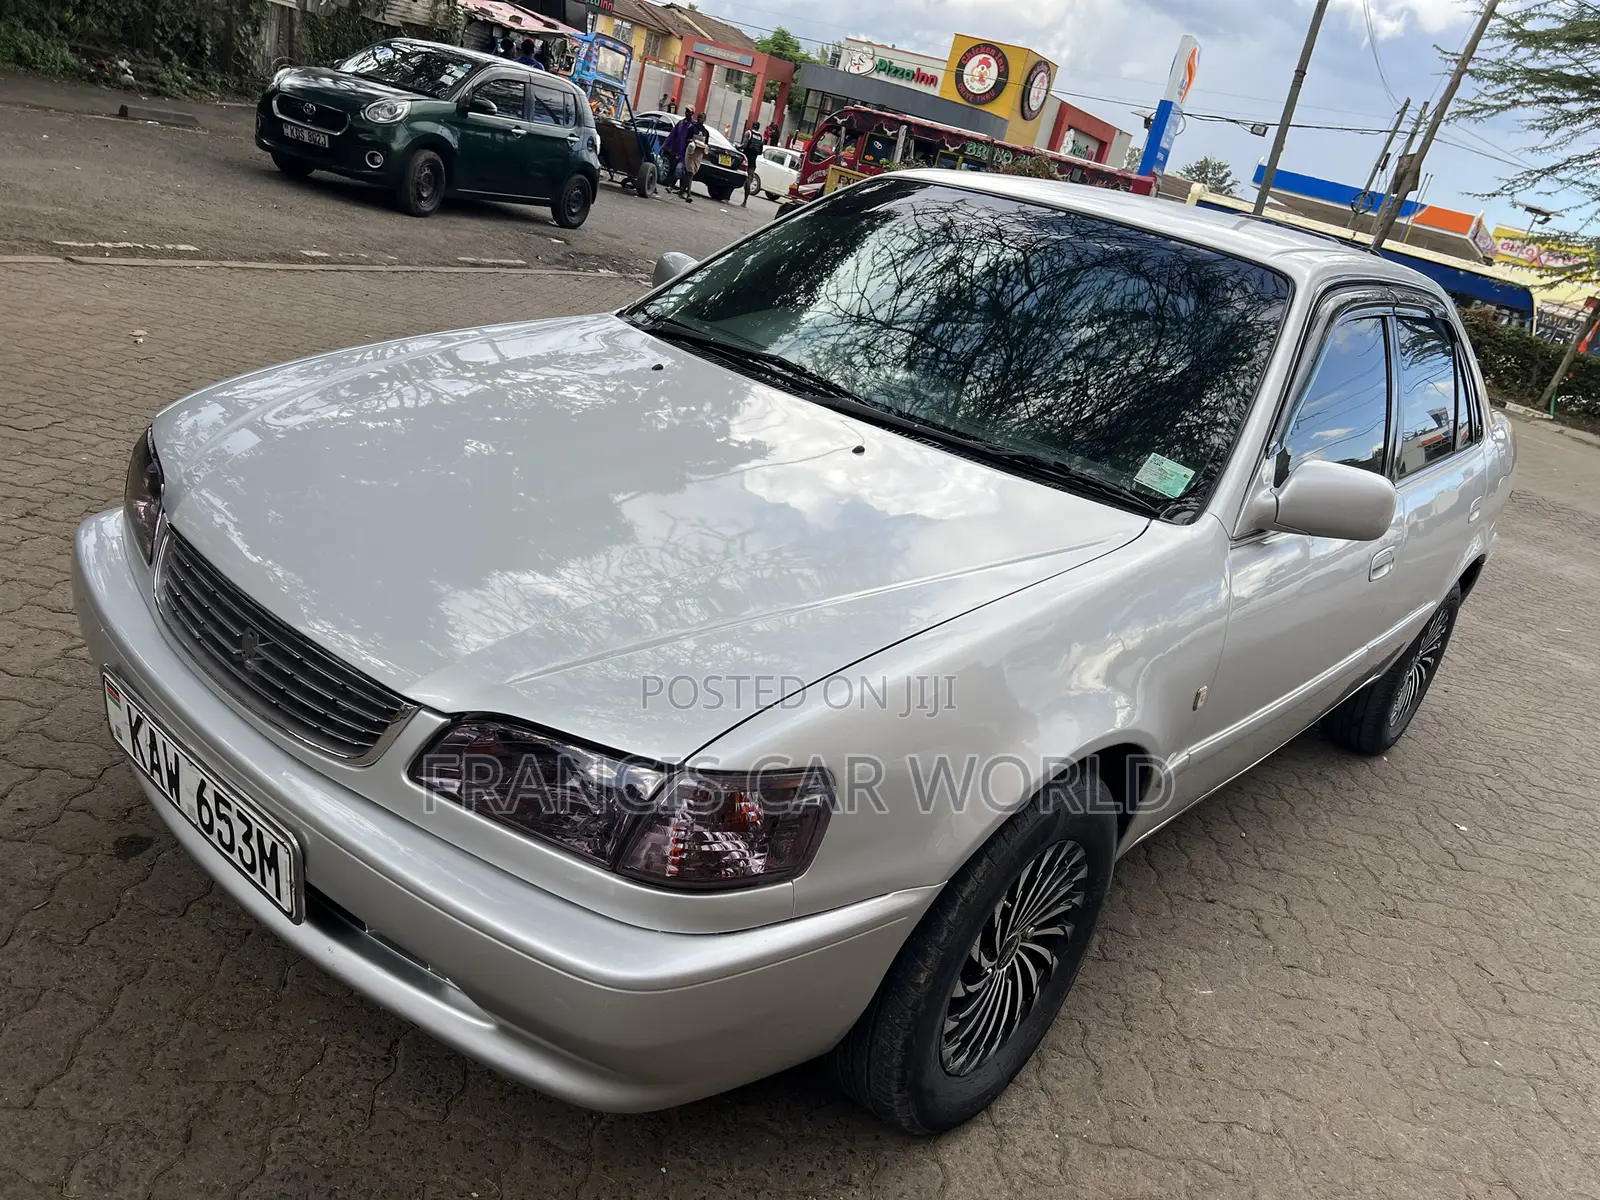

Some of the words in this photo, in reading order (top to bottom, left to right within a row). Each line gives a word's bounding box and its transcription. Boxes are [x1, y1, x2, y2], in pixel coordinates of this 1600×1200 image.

[961, 44, 996, 65] Chicken
[995, 53, 1005, 73] Inn
[958, 83, 974, 101] DRIVE
[976, 89, 995, 102] THRU
[127, 704, 181, 806] KAW
[196, 779, 282, 902] 653M
